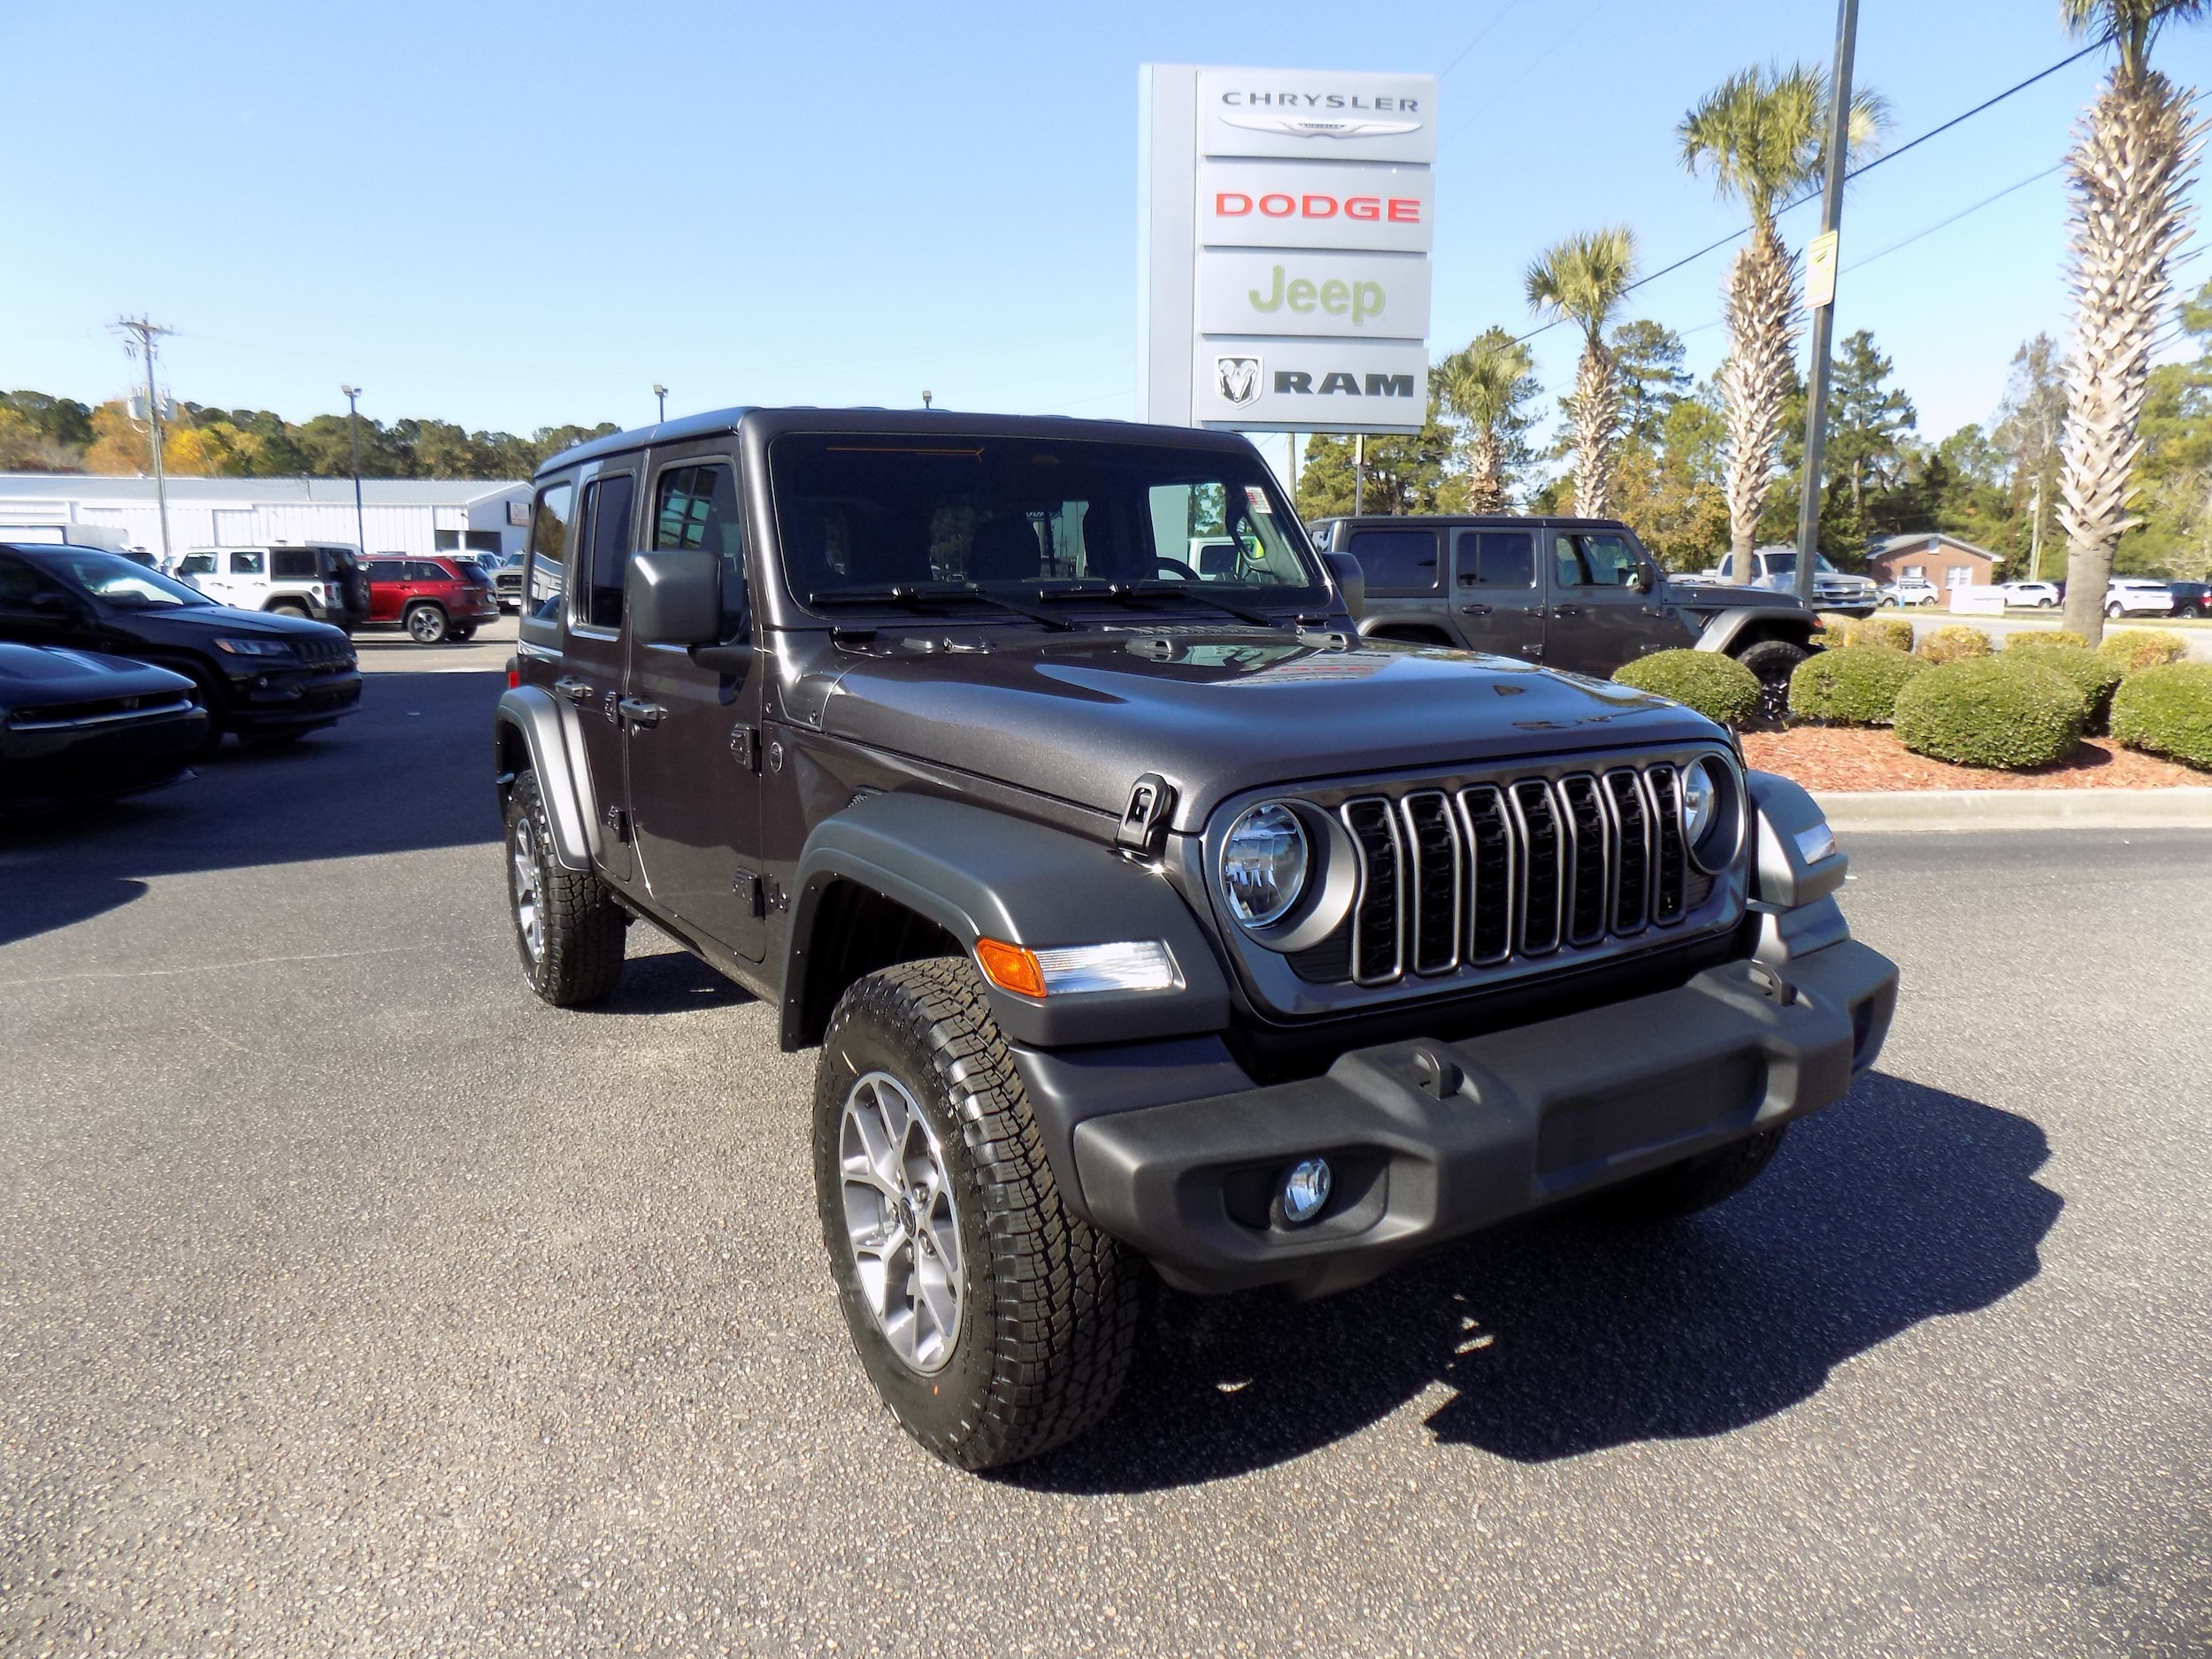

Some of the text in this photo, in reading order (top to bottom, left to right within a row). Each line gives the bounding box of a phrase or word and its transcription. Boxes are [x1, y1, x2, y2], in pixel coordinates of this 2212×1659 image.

[1221, 92, 1418, 112] CHRYSLER
[1216, 193, 1421, 223] DODGE
[1248, 265, 1385, 326] Jeep
[1274, 371, 1414, 397] RAM
